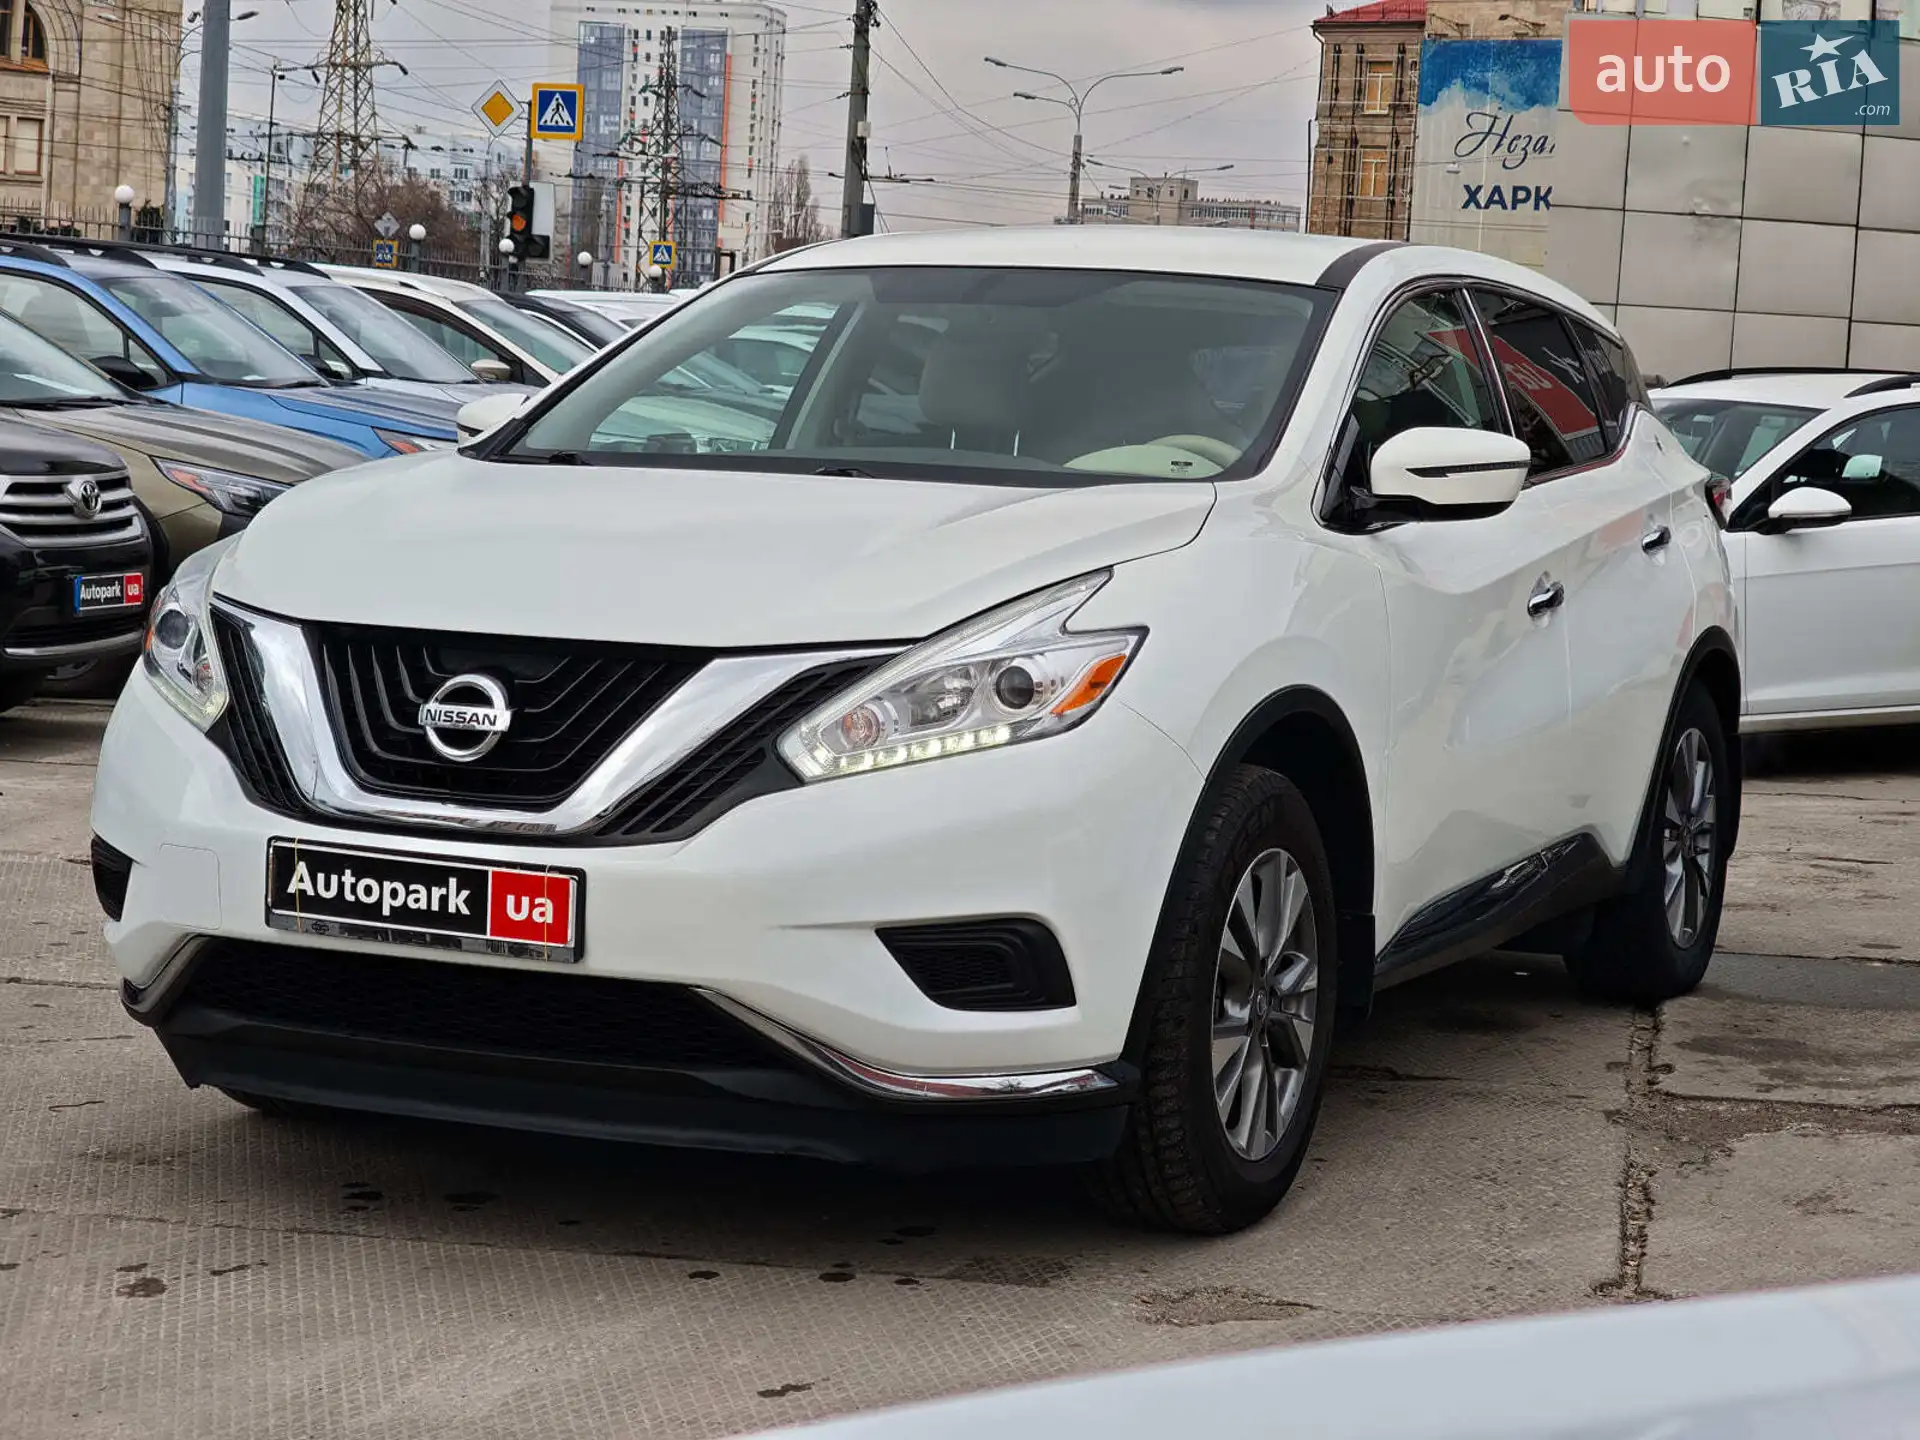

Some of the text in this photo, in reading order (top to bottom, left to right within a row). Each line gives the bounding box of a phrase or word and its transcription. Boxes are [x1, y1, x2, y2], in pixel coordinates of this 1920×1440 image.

[1454, 112, 1556, 170] Неза
[1461, 184, 1553, 211] ХАРК
[80, 580, 139, 603] Autopark ua
[425, 709, 497, 726] NISSAN
[287, 861, 554, 924] Autopark ua
